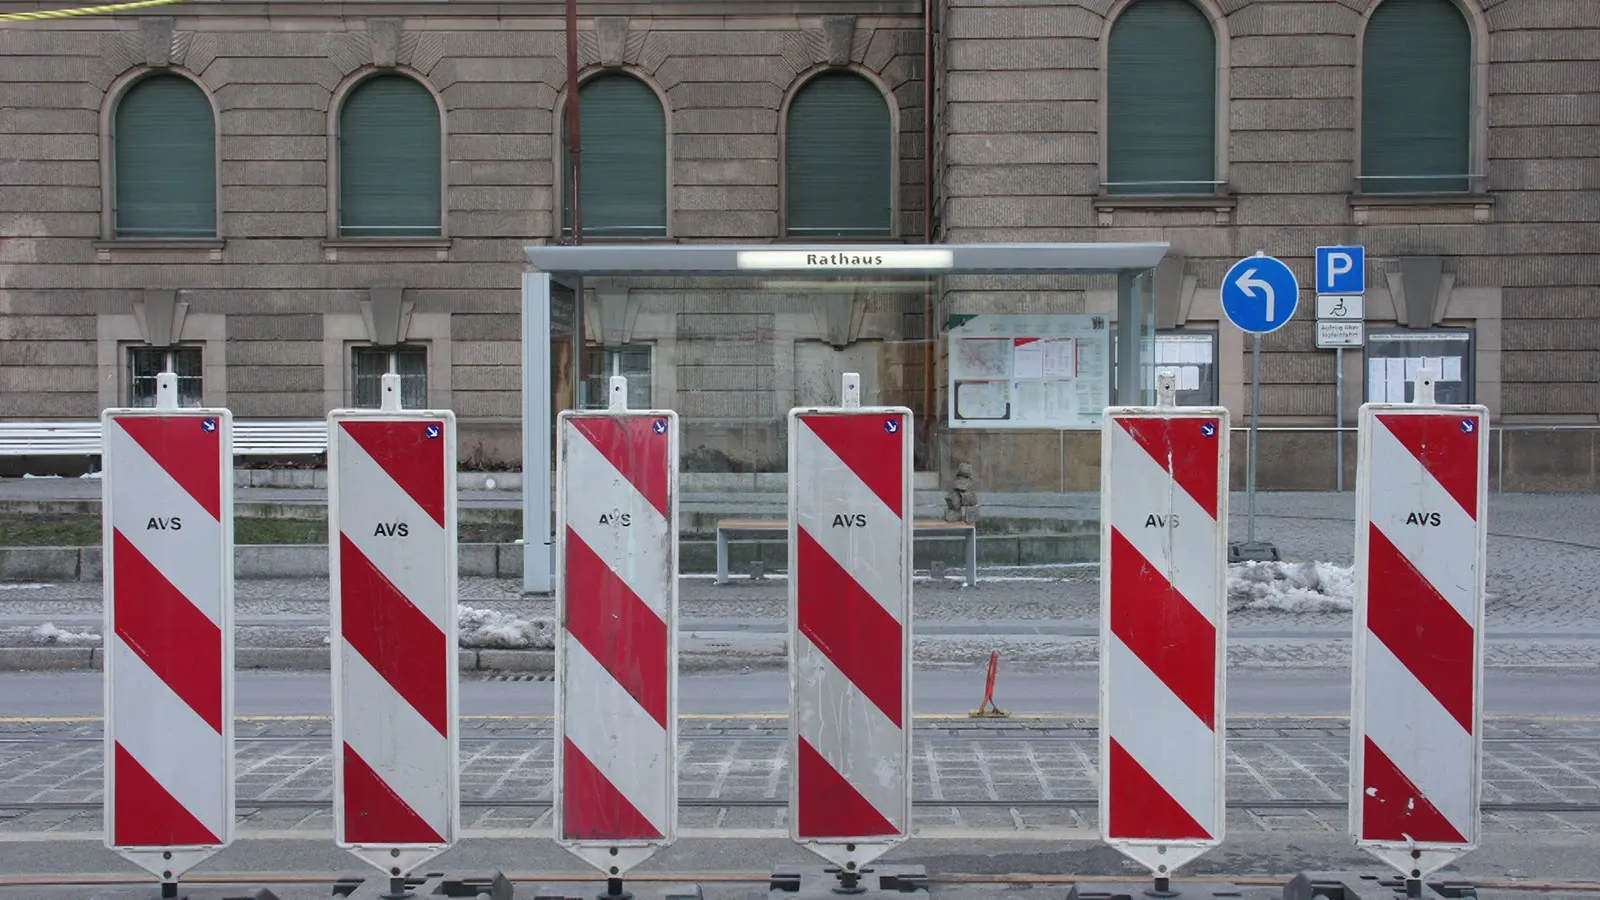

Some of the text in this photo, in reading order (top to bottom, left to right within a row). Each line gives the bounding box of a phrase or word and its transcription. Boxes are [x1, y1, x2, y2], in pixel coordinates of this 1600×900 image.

[806, 252, 883, 265] Rathaus
[1327, 252, 1353, 287] P
[146, 517, 182, 531] AVS
[832, 514, 866, 528] AVS
[1145, 514, 1180, 528] AVS
[1406, 512, 1441, 527] AVS
[374, 522, 409, 536] AVS
